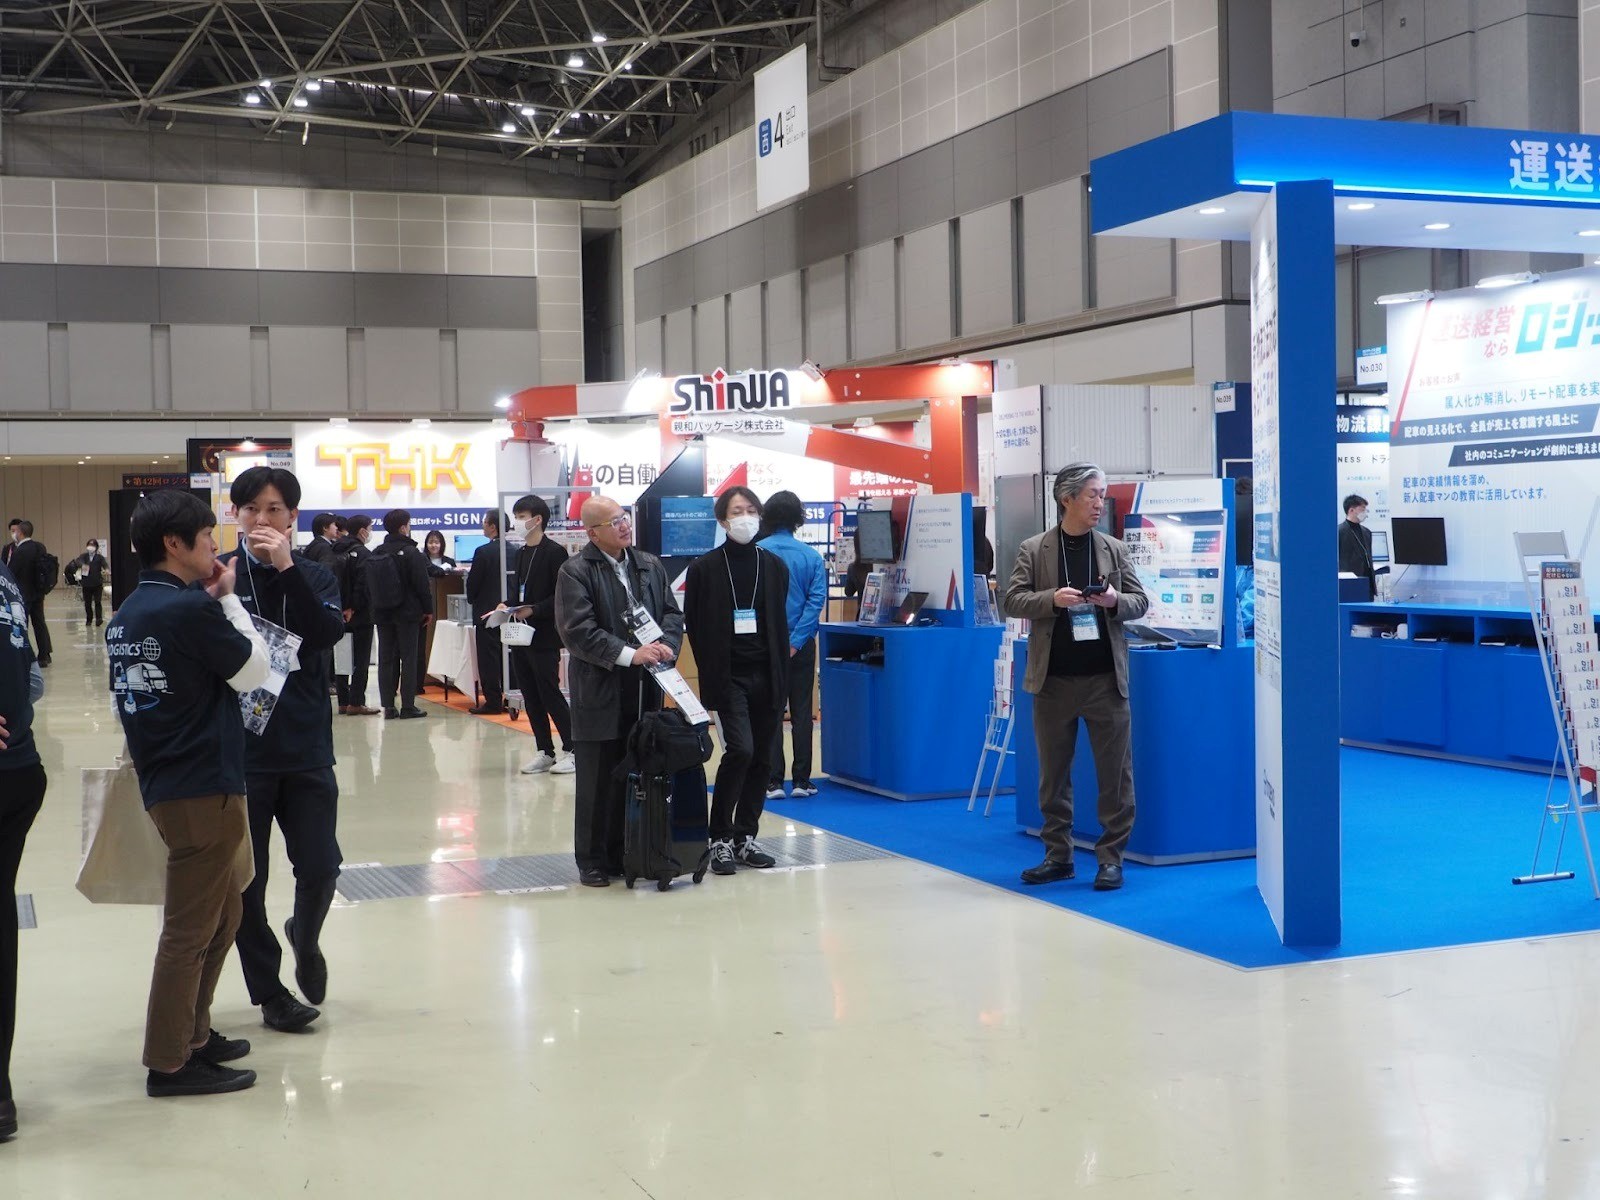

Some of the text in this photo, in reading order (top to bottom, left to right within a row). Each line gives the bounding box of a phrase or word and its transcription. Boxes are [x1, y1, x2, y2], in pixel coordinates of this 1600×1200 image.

[774, 111, 784, 148] 4
[1509, 139, 1600, 194] 運送
[1483, 340, 1509, 358] なら
[673, 419, 785, 432] 親和パッケージ株式会社
[315, 442, 472, 491] THK
[107, 625, 124, 639] LOVE
